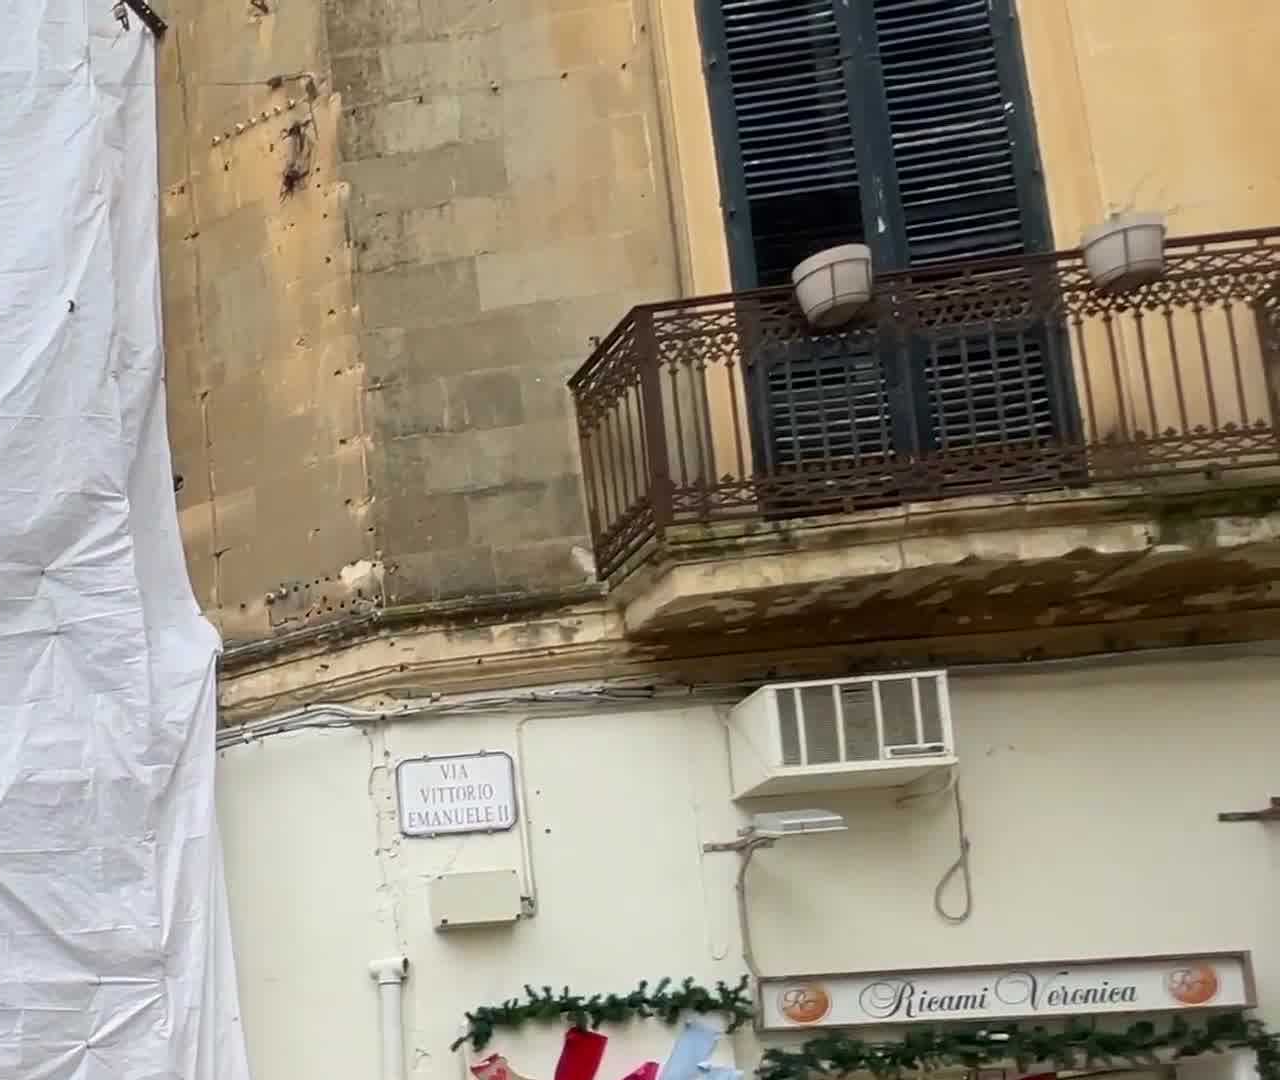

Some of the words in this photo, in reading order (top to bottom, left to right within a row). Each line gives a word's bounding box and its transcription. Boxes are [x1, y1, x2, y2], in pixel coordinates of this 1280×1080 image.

[440, 763, 469, 779] VIA
[419, 783, 494, 804] VITTORIO
[408, 807, 495, 828] EMANUELE
[498, 805, 509, 822] II
[859, 977, 988, 1019] Ricami
[994, 967, 1137, 1012] Veronica
